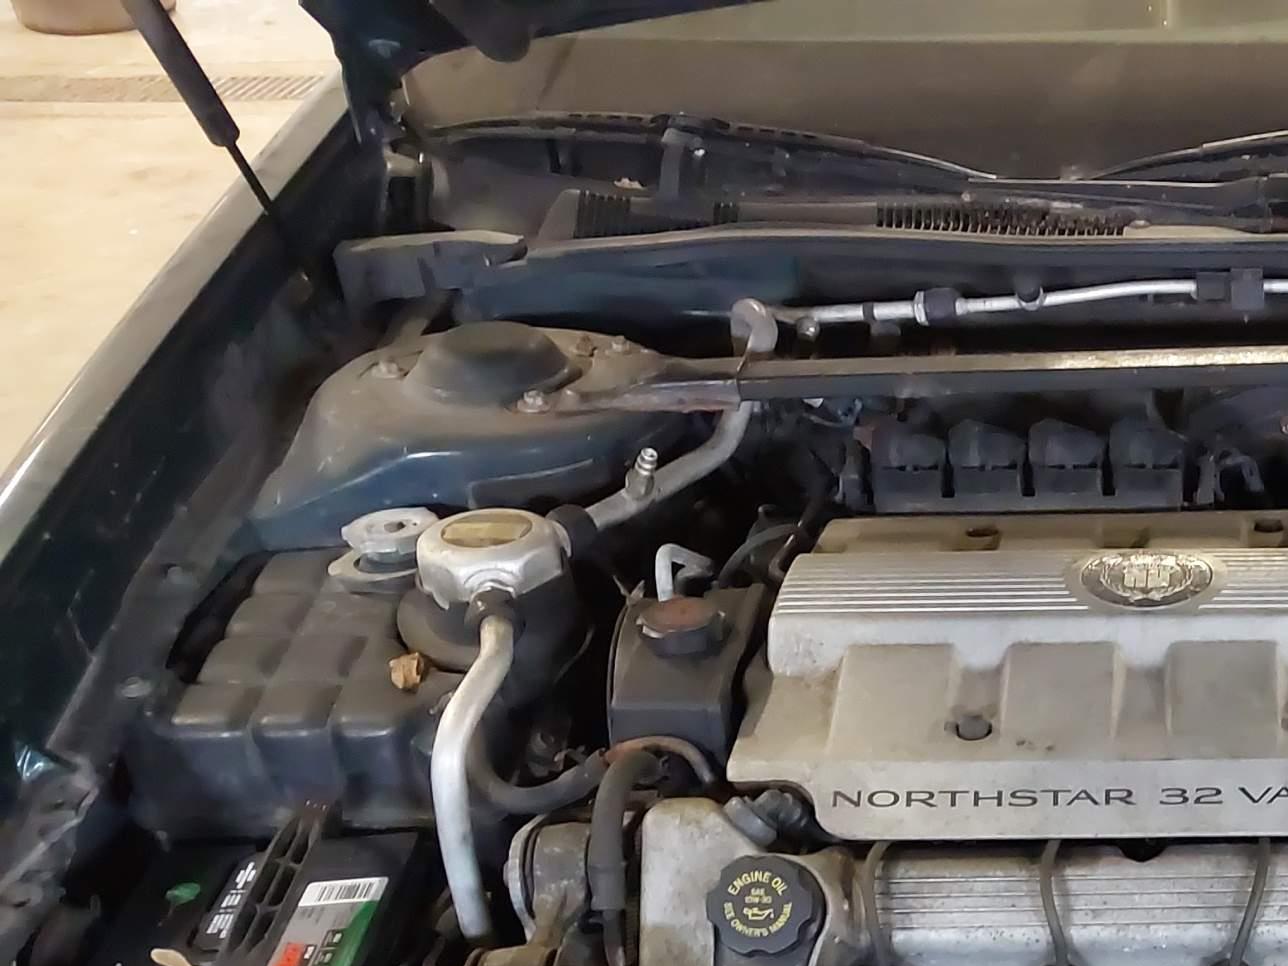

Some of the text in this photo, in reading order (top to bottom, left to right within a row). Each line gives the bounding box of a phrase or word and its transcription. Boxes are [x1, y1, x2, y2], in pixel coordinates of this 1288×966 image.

[832, 788, 1137, 808] NORTHSTAR
[1159, 787, 1224, 805] 32
[727, 870, 788, 896] ENGINE OIL
